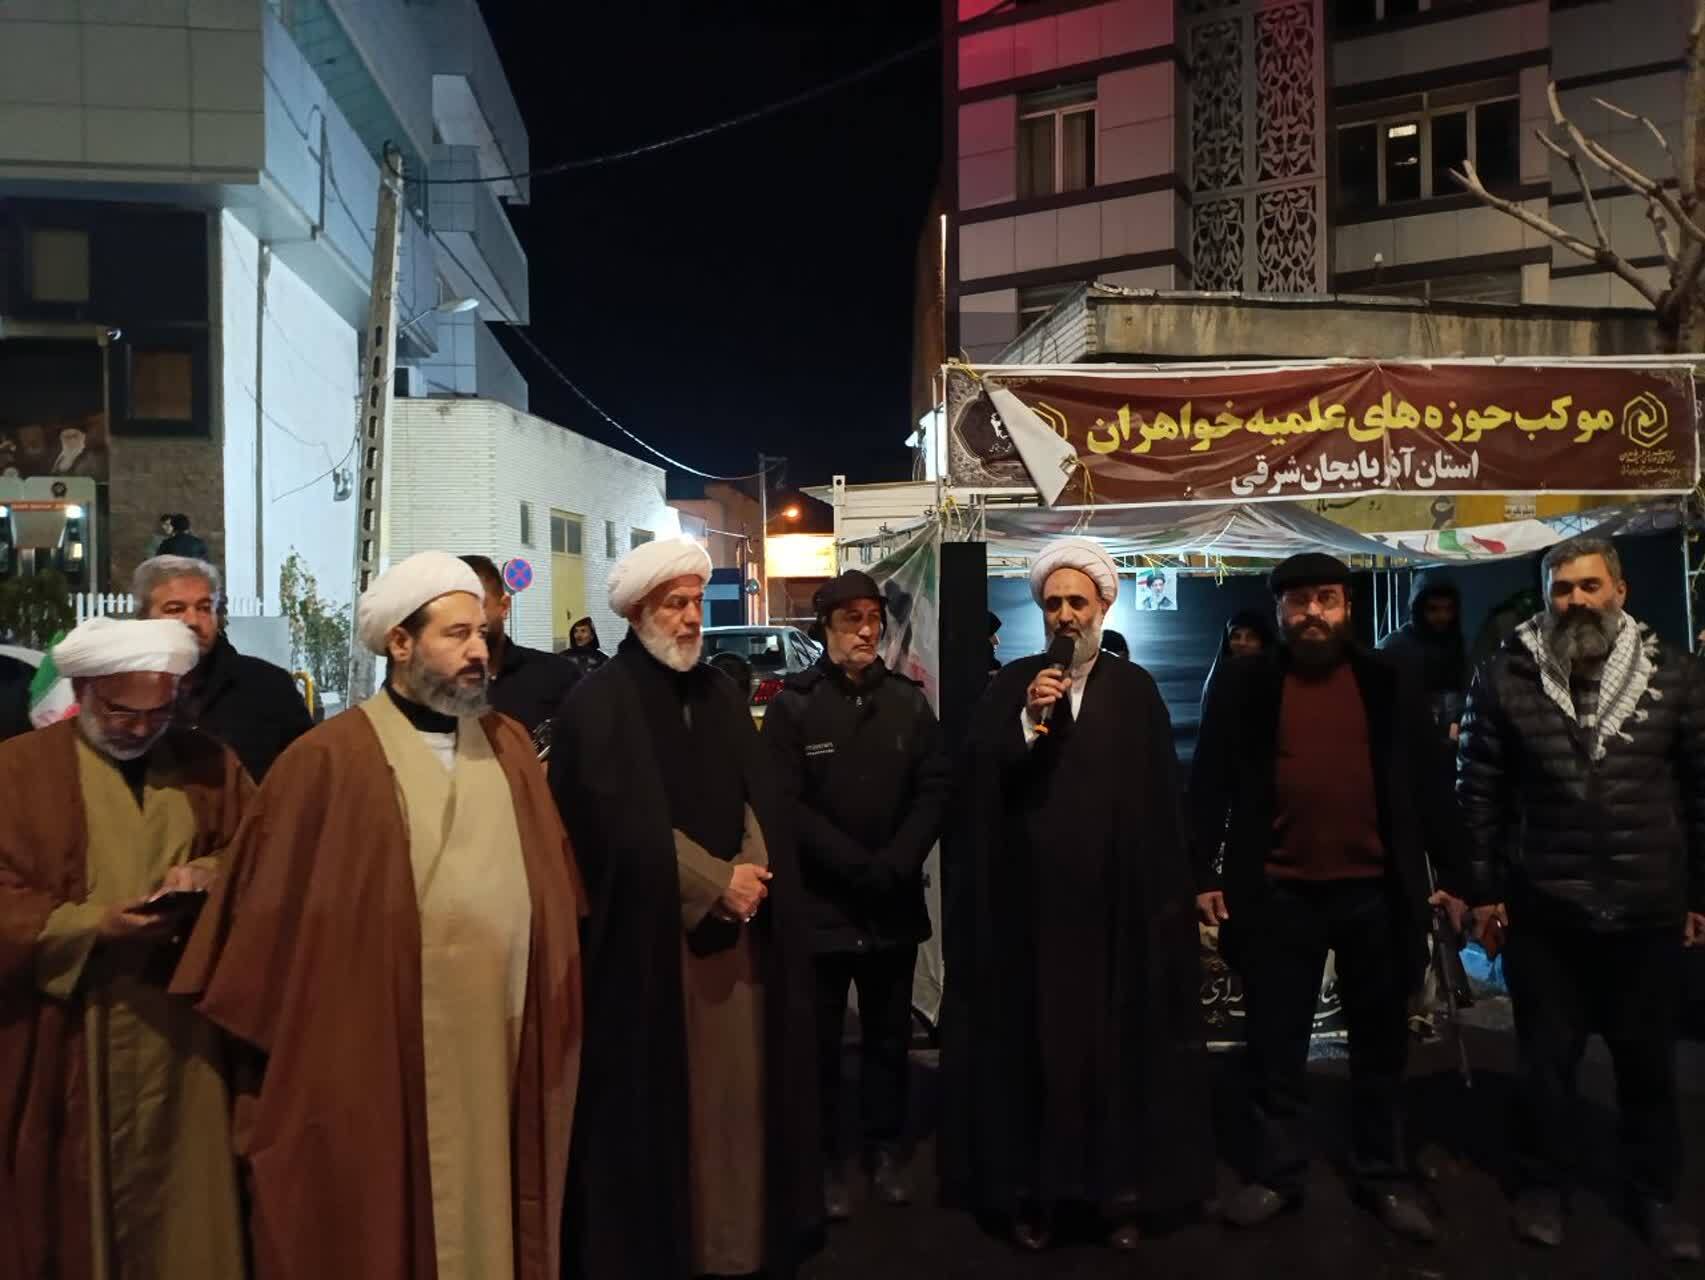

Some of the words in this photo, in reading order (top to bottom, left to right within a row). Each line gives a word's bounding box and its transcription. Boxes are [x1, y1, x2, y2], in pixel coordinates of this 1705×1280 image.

[1086, 400, 1244, 454] خواهران
[1245, 396, 1346, 446] علمیه
[1514, 395, 1614, 443] موکب
[1230, 454, 1301, 496] شرقی
[1414, 449, 1480, 488] استان
